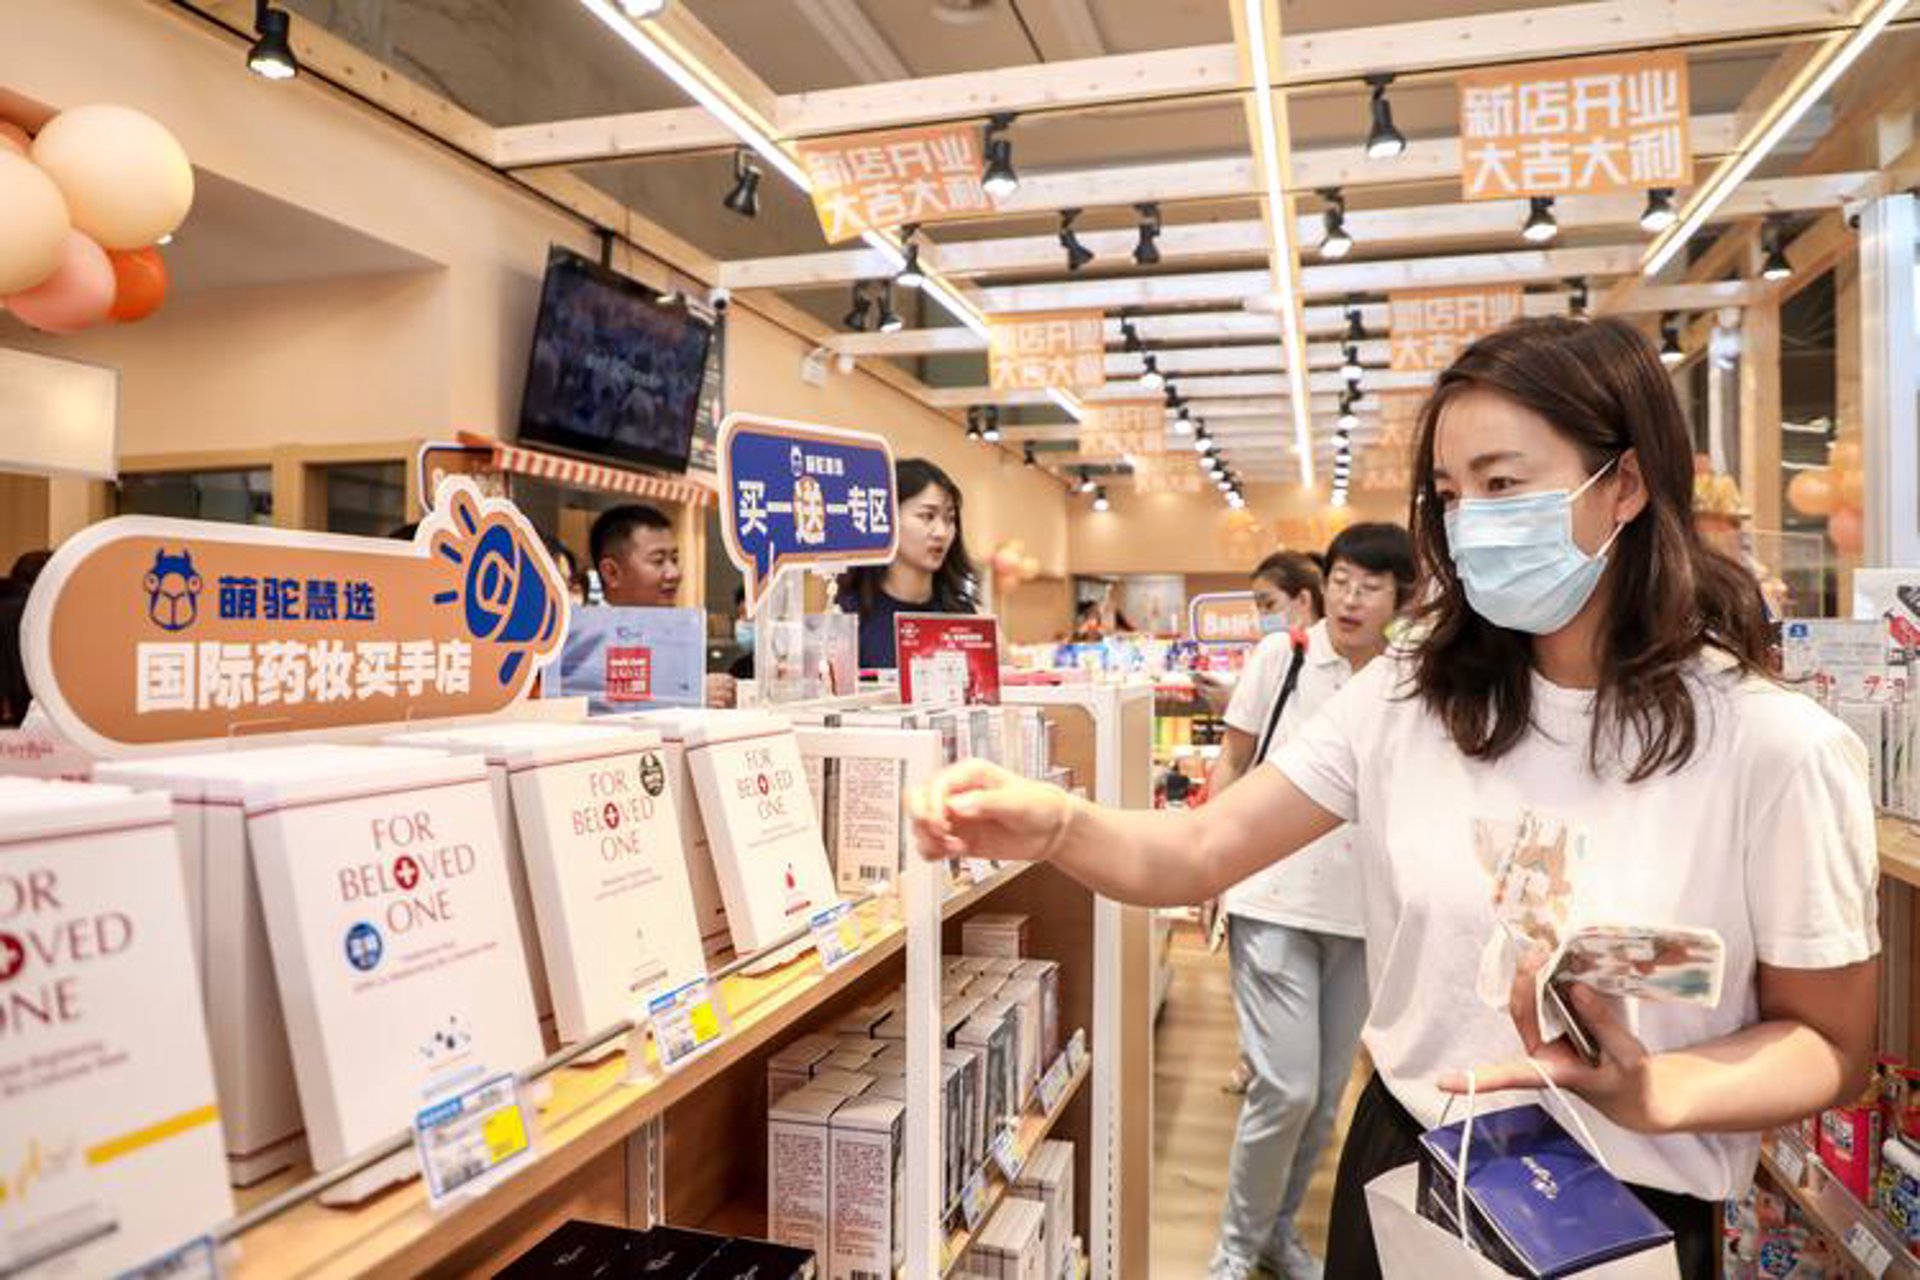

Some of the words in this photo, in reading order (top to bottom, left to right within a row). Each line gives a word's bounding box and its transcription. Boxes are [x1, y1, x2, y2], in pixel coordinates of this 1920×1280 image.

[1463, 70, 1680, 137] 新店开业
[807, 134, 976, 188] 新店开业
[1466, 126, 1682, 191] 大吉大利
[819, 174, 988, 242] 大吉大利
[738, 477, 890, 545] 买一送一专区
[217, 575, 376, 621] 萌驼慧选
[136, 639, 472, 714] 国际药妆买手店
[589, 768, 632, 798] FOR
[371, 811, 434, 851] FOR
[571, 796, 655, 836] BELOVED
[337, 843, 476, 903] BELOVED
[600, 829, 642, 862] ONE
[0, 868, 63, 921] OR
[386, 889, 455, 935] ONE
[0, 911, 134, 985] OVED
[0, 975, 84, 1038] NE
